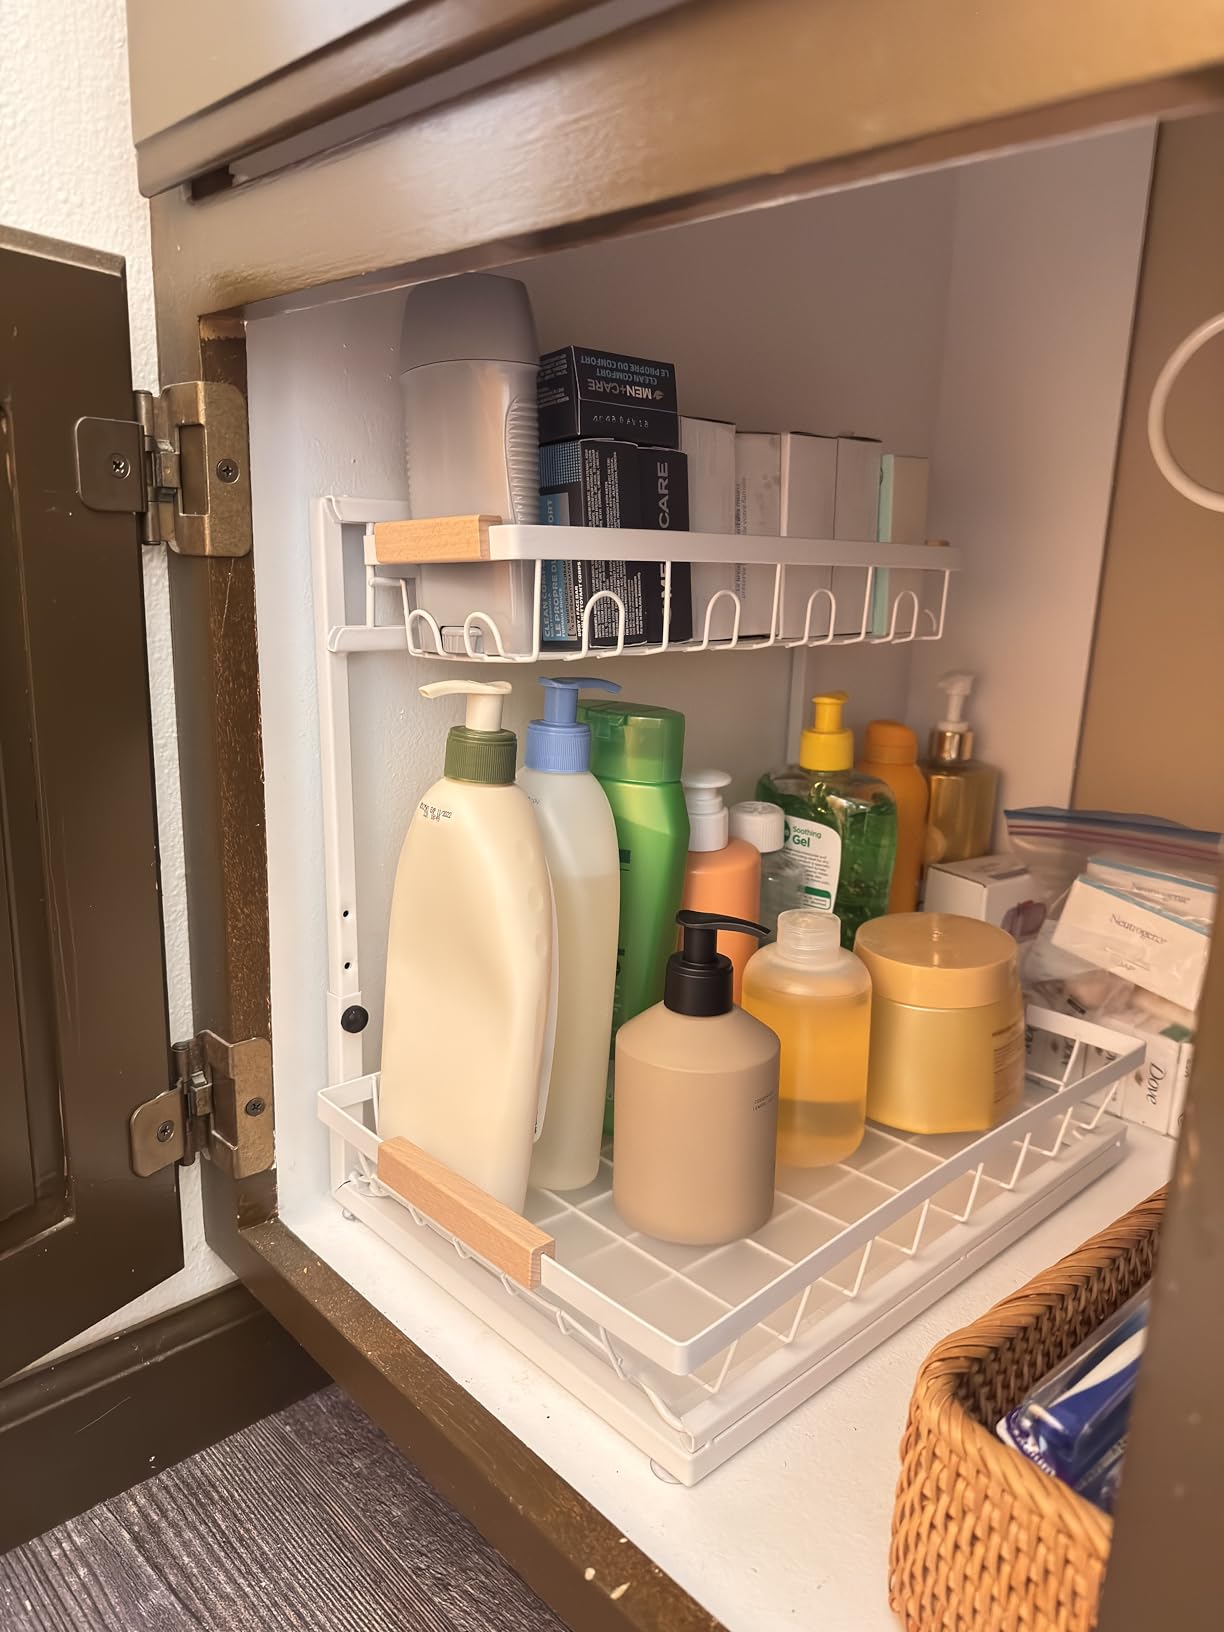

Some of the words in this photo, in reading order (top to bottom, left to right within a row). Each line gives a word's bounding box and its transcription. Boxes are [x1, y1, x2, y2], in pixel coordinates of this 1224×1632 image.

[596, 368, 633, 382] COMFORT
[632, 374, 658, 385] CLEAN
[587, 378, 652, 400] MEN+CARE
[553, 575, 561, 621] PROPRE
[556, 623, 562, 637] LE
[792, 826, 822, 839] Soothing
[792, 835, 811, 848] Gel
[1146, 1062, 1166, 1105] Dove
